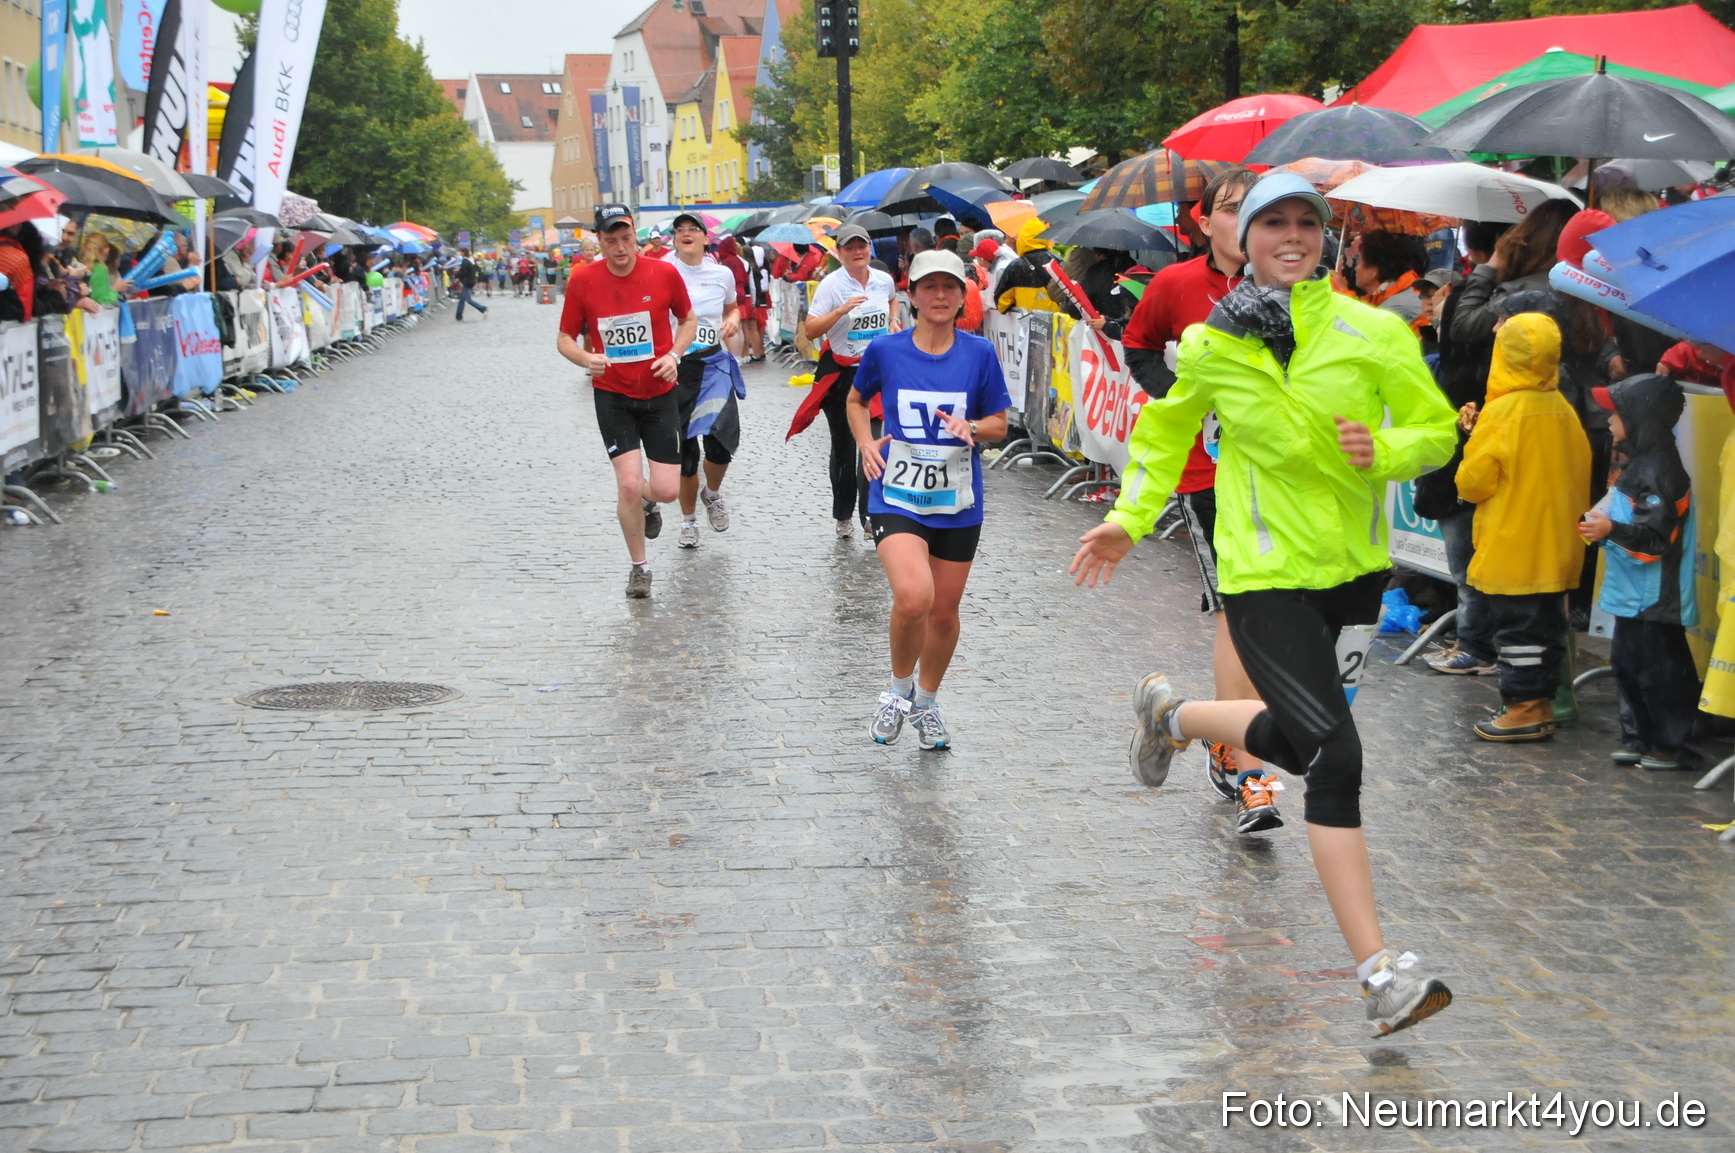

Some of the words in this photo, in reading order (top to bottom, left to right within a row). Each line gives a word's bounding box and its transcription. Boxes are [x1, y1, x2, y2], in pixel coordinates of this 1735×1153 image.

[276, 60, 294, 112] BKK
[267, 119, 287, 178] Audi
[1562, 268, 1628, 307] seCenter
[852, 312, 886, 331] 2898
[605, 325, 648, 346] 2362
[694, 327, 716, 345] 99
[618, 347, 638, 357] Georg
[891, 460, 949, 490] 2761
[907, 492, 932, 505] Stilla
